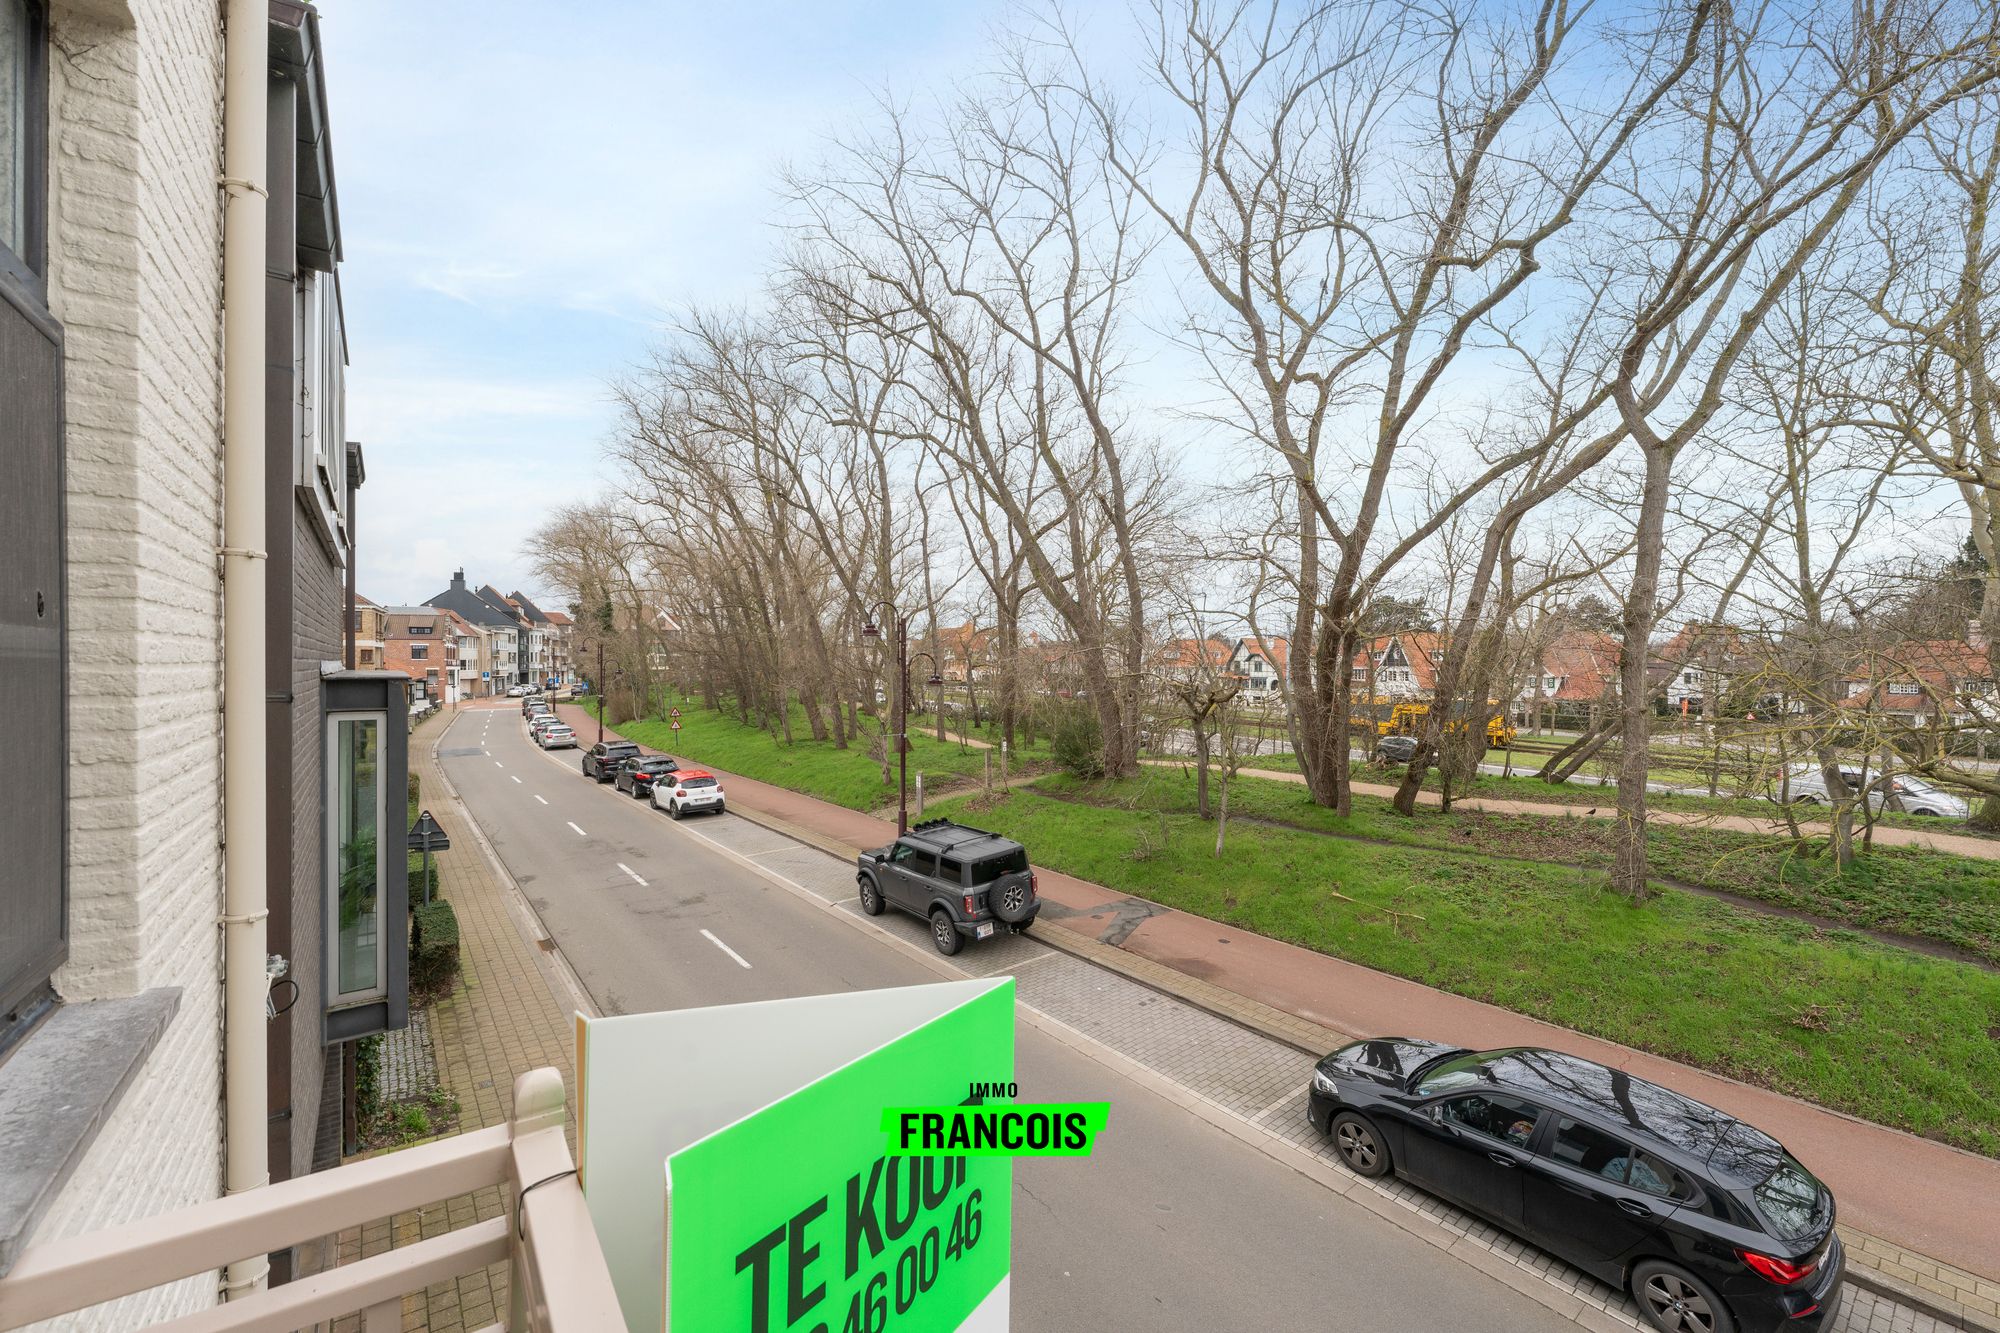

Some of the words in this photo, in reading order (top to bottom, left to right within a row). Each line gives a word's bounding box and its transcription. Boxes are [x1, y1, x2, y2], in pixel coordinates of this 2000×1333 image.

[735, 1194, 828, 1333] TE
[842, 1271, 887, 1333] 46
[895, 1226, 939, 1316] 00
[945, 1188, 982, 1262] 46
